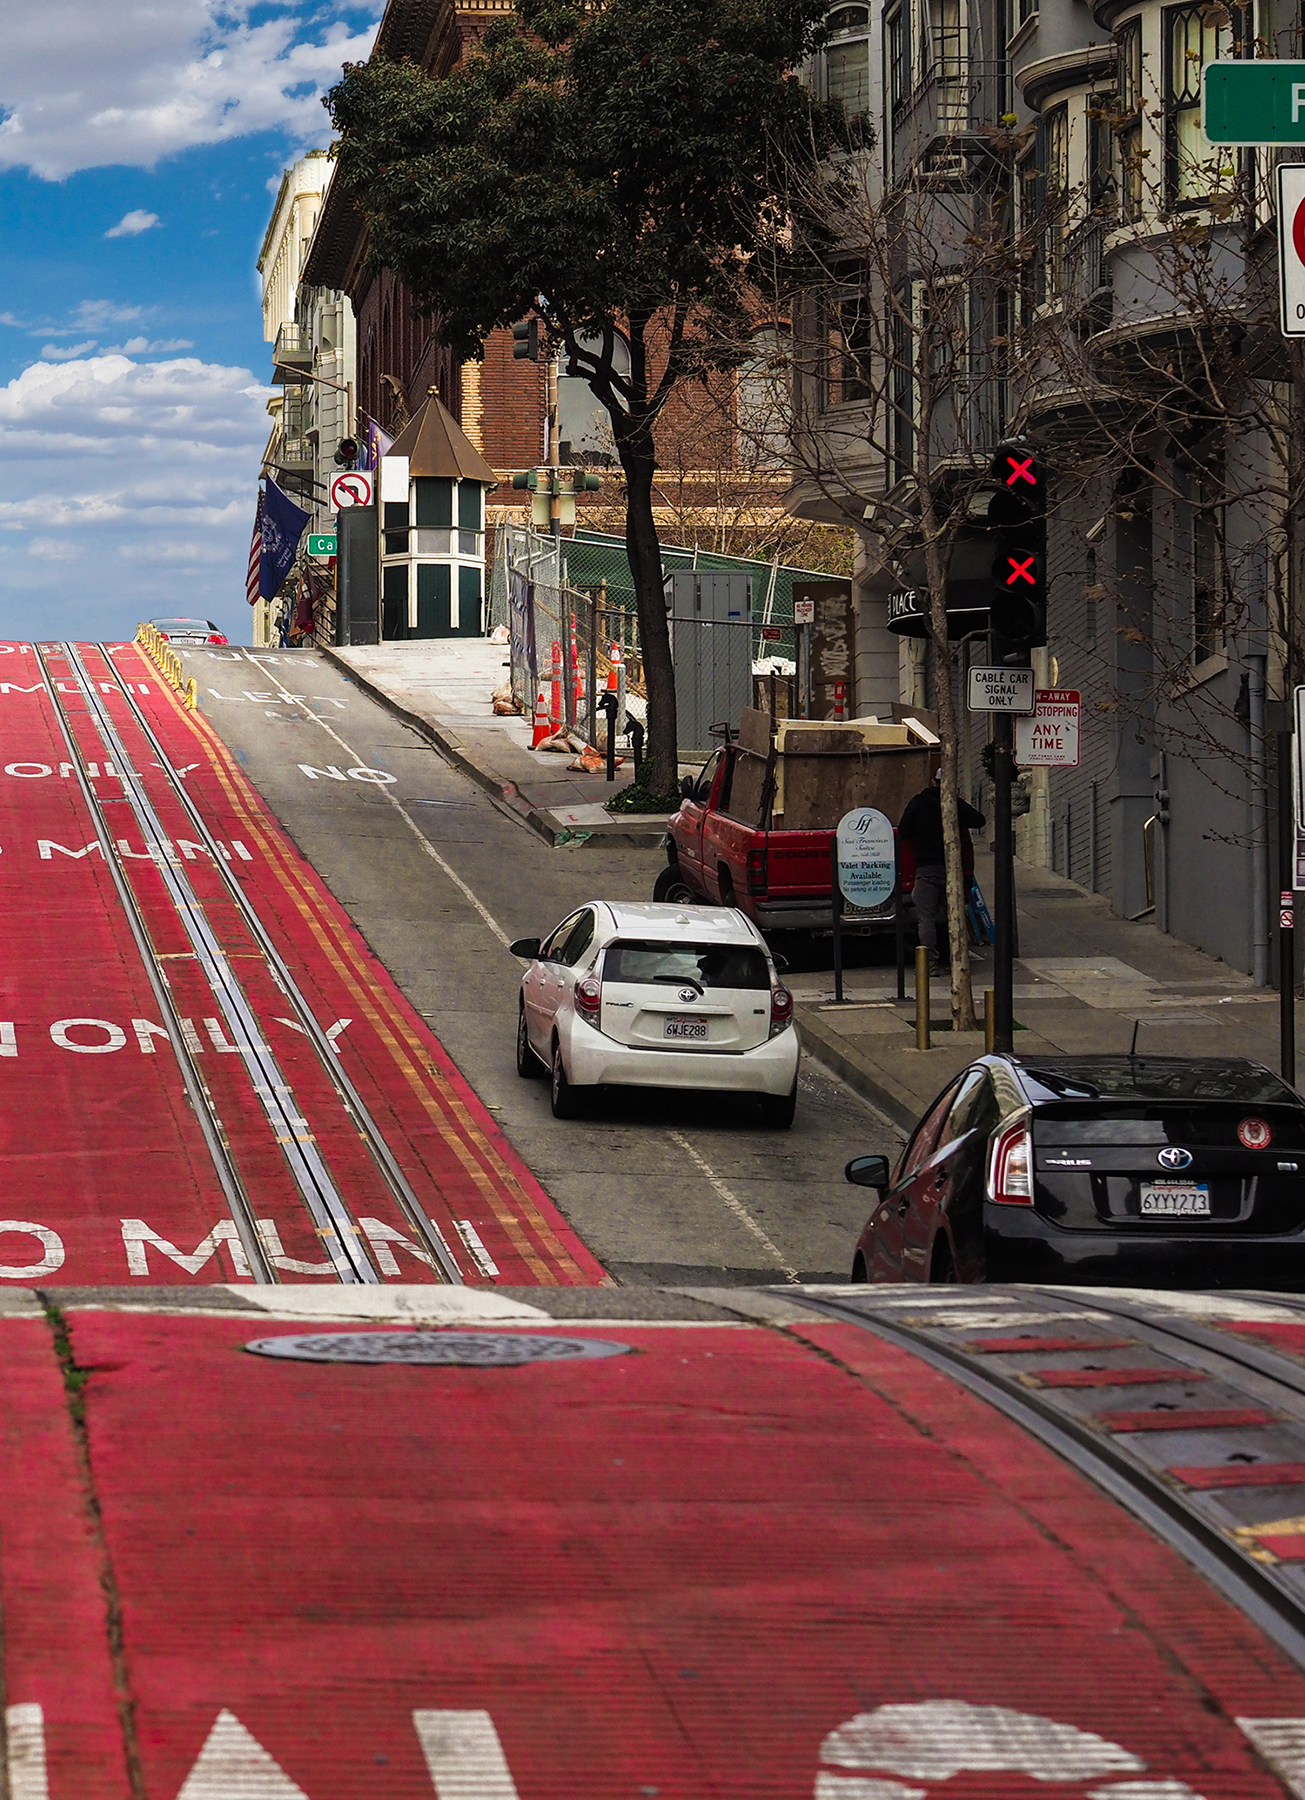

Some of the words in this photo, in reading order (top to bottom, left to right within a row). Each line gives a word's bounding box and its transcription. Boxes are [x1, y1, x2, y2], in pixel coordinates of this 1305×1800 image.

[975, 672, 1005, 683] CABLE
[1009, 674, 1029, 684] CAR
[0, 681, 151, 695] MUNI
[984, 684, 1018, 695] SIGNAL
[207, 688, 350, 708] LEFT
[988, 696, 1014, 706] ONLY
[1036, 692, 1071, 701] W-AWAY
[1036, 705, 1078, 718] STOPPING
[1033, 724, 1062, 736] ANY
[1030, 737, 1064, 750] TIME
[4, 760, 204, 778] ONLY
[296, 763, 398, 785] NO
[37, 837, 254, 861] MUNI
[840, 861, 859, 870] Valet
[861, 861, 891, 870] Parking
[849, 872, 882, 880] Available
[50, 1016, 354, 1056] ONLY
[666, 1023, 707, 1037] 6WJE288
[1143, 1193, 1208, 1210] 6YYY273
[121, 1218, 502, 1279] MUNI
